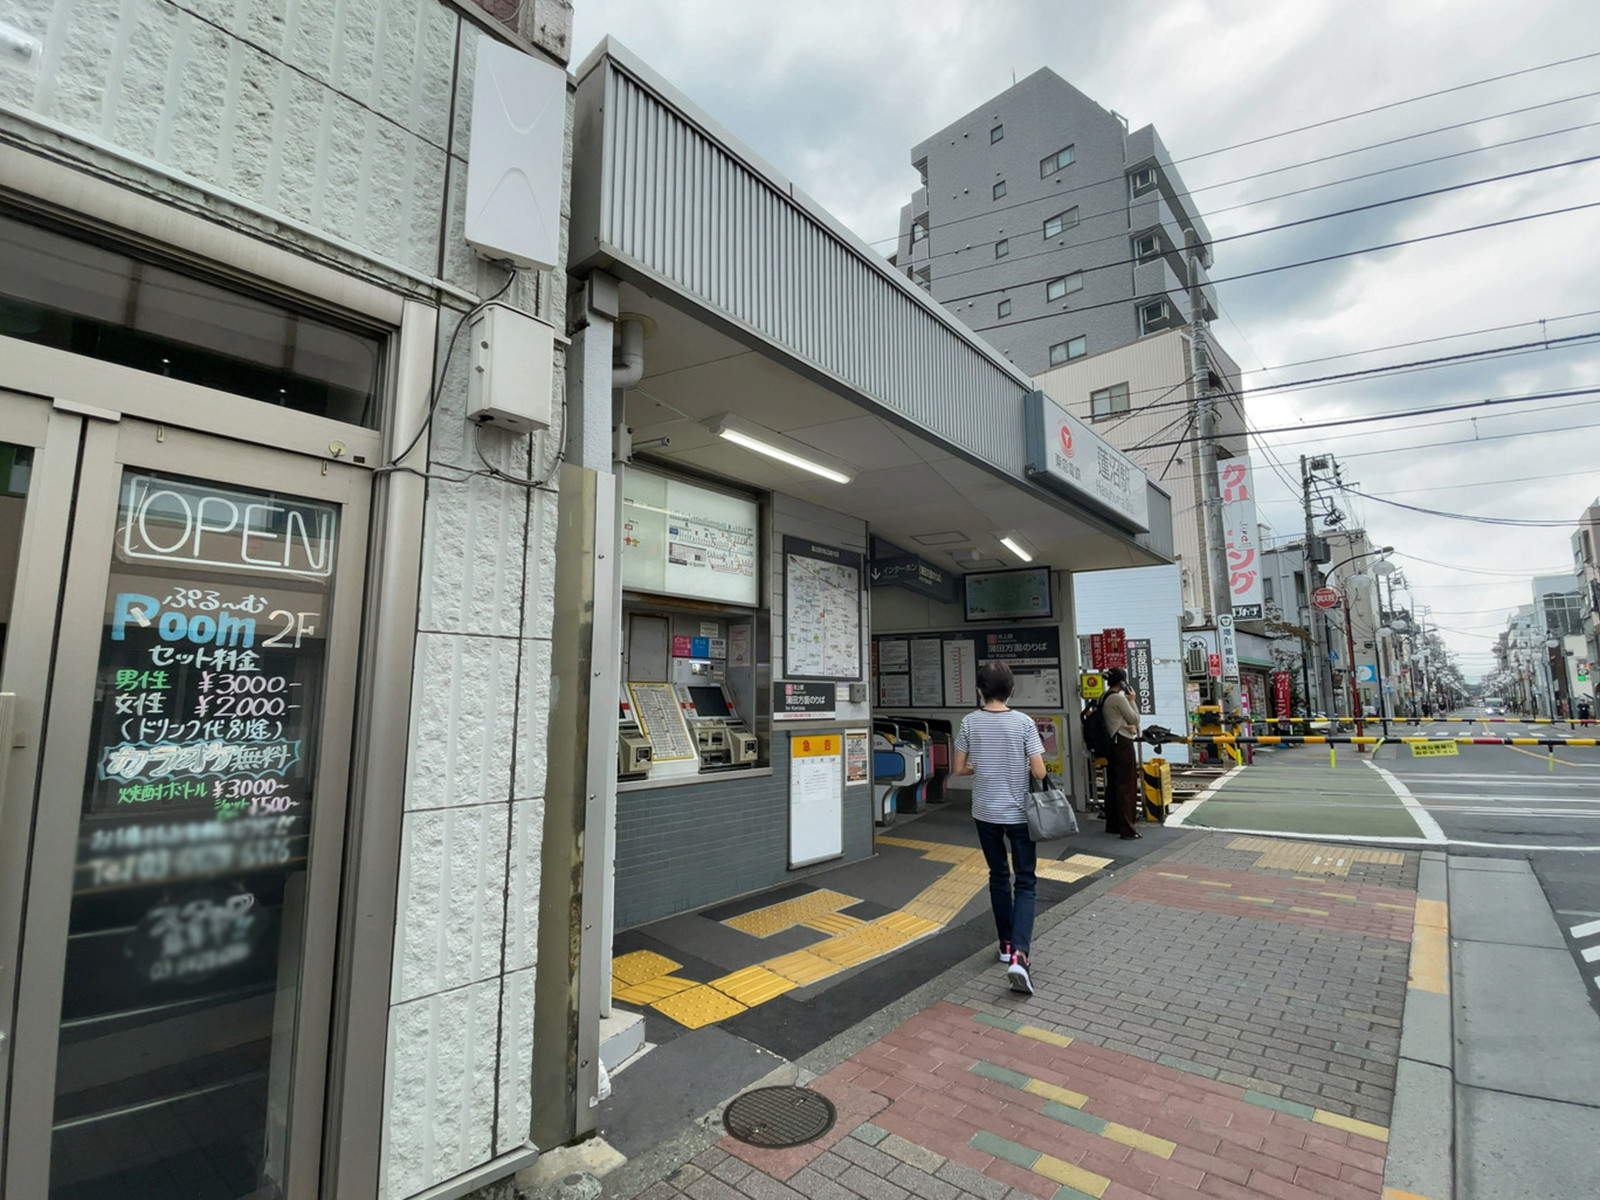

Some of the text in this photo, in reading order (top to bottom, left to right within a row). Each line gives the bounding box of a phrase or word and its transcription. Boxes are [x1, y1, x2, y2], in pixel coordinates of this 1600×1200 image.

[1097, 445, 1131, 495] 蓮沼駅
[139, 490, 327, 569] OPEN
[262, 610, 320, 648] 2F
[149, 645, 260, 671] セット料金
[115, 669, 172, 691] 男性
[1137, 649, 1151, 713] 五反田方面のりば
[1277, 674, 1287, 719] クリーニン
[115, 692, 167, 716] 女性
